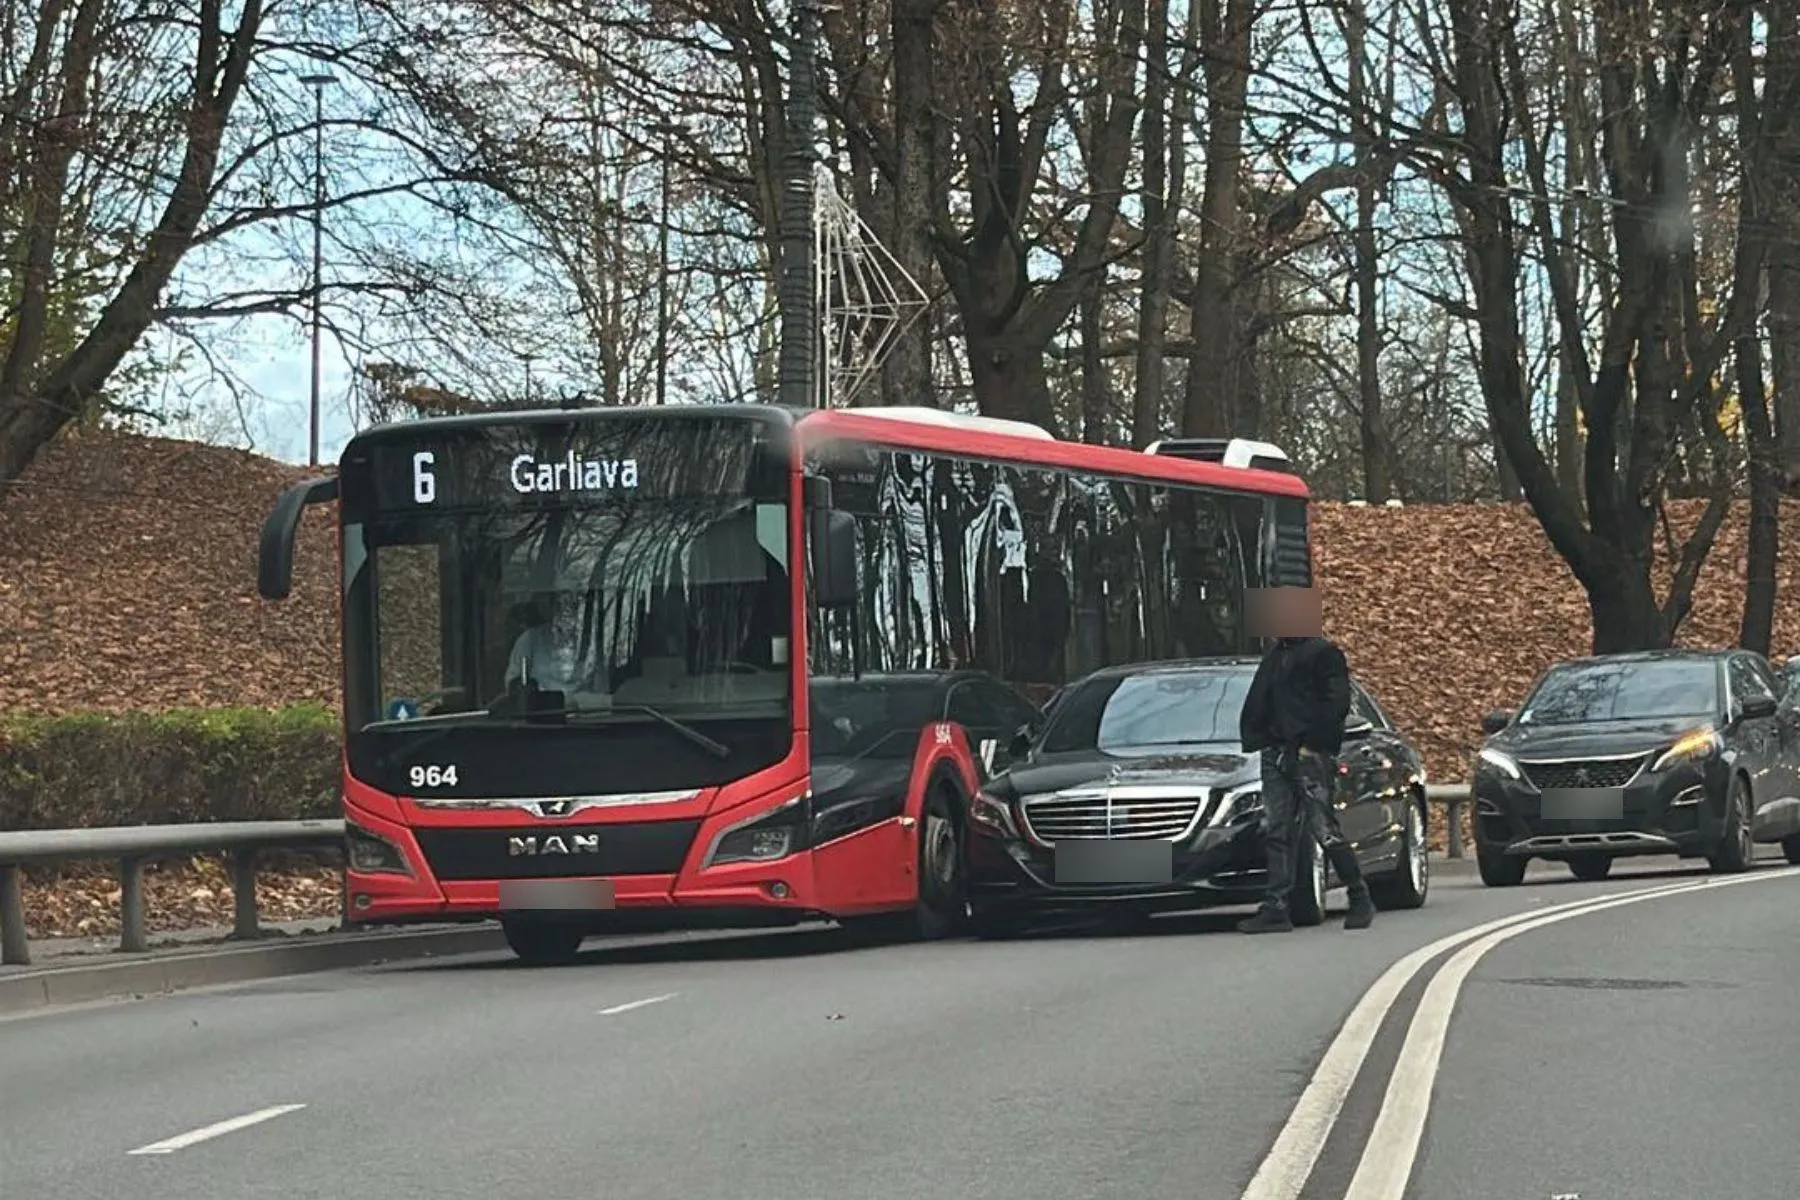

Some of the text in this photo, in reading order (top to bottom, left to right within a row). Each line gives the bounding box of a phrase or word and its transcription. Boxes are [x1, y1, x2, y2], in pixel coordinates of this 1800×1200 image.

[413, 450, 638, 503] 6 Garliava
[410, 765, 458, 787] 964
[508, 834, 600, 856] MAN
